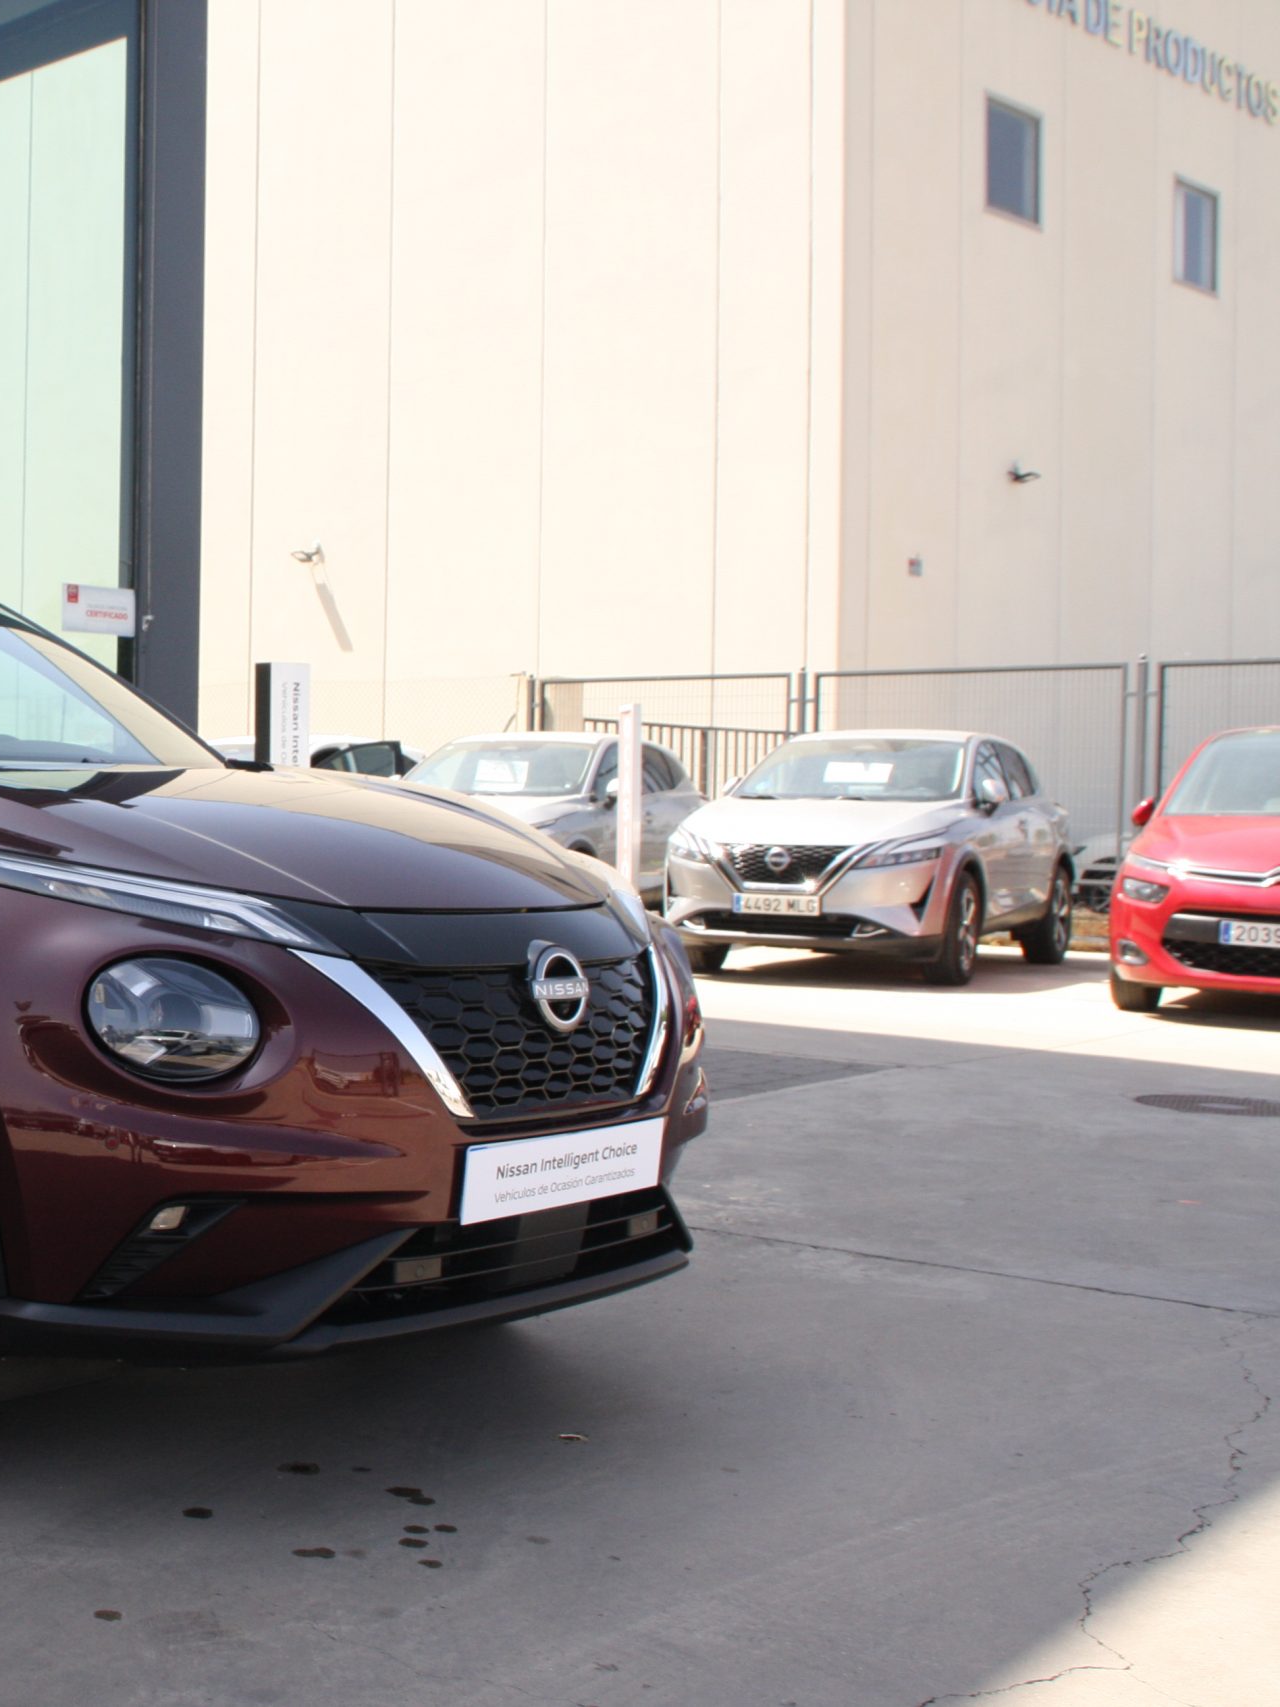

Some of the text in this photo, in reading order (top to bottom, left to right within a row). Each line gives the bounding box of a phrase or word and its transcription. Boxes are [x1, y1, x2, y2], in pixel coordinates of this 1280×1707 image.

[1084, 0, 1278, 125] DE PRODUCTOS
[85, 609, 128, 621] CERTIFICADO
[744, 896, 816, 914] 4492 MLG
[535, 981, 589, 996] NISSAN
[496, 1142, 638, 1181] Nissan Intelligent Choice
[537, 1183, 549, 1196] de
[584, 1167, 636, 1187] Garantizados
